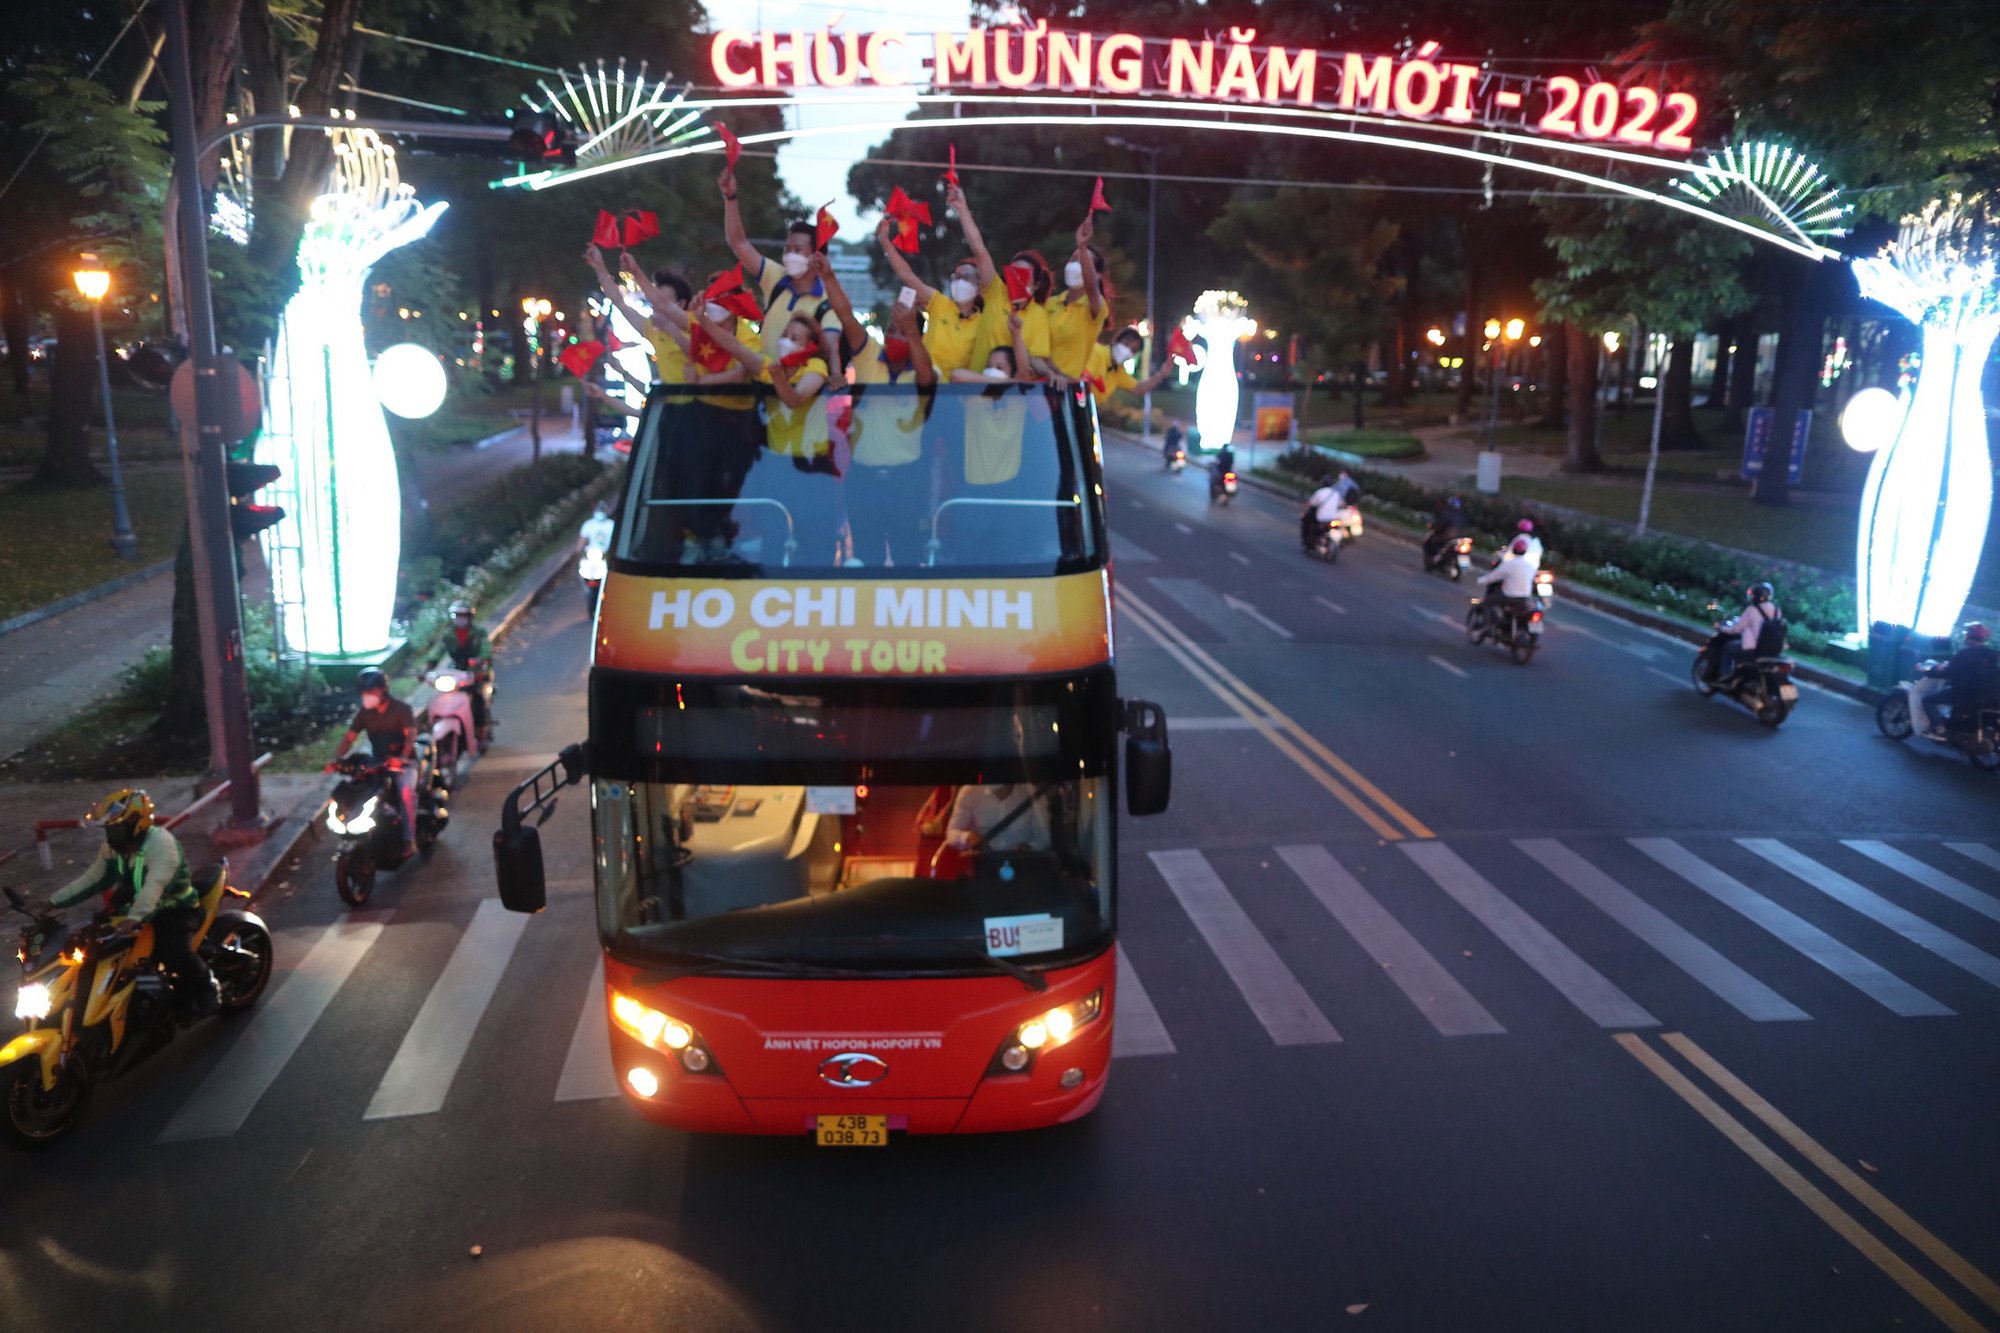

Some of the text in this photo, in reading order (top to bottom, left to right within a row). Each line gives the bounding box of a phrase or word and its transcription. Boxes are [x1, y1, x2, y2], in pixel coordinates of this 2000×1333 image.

[710, 11, 909, 89] CHÚC
[933, 9, 1144, 92] MỪNG
[1167, 26, 1318, 105] NĂM
[1337, 40, 1480, 123] MỚI
[1539, 75, 1699, 152] 2022
[648, 587, 1034, 630] HO CHI MINH
[824, 1130, 880, 1144] 038.73
[837, 1116, 867, 1130] 43B
